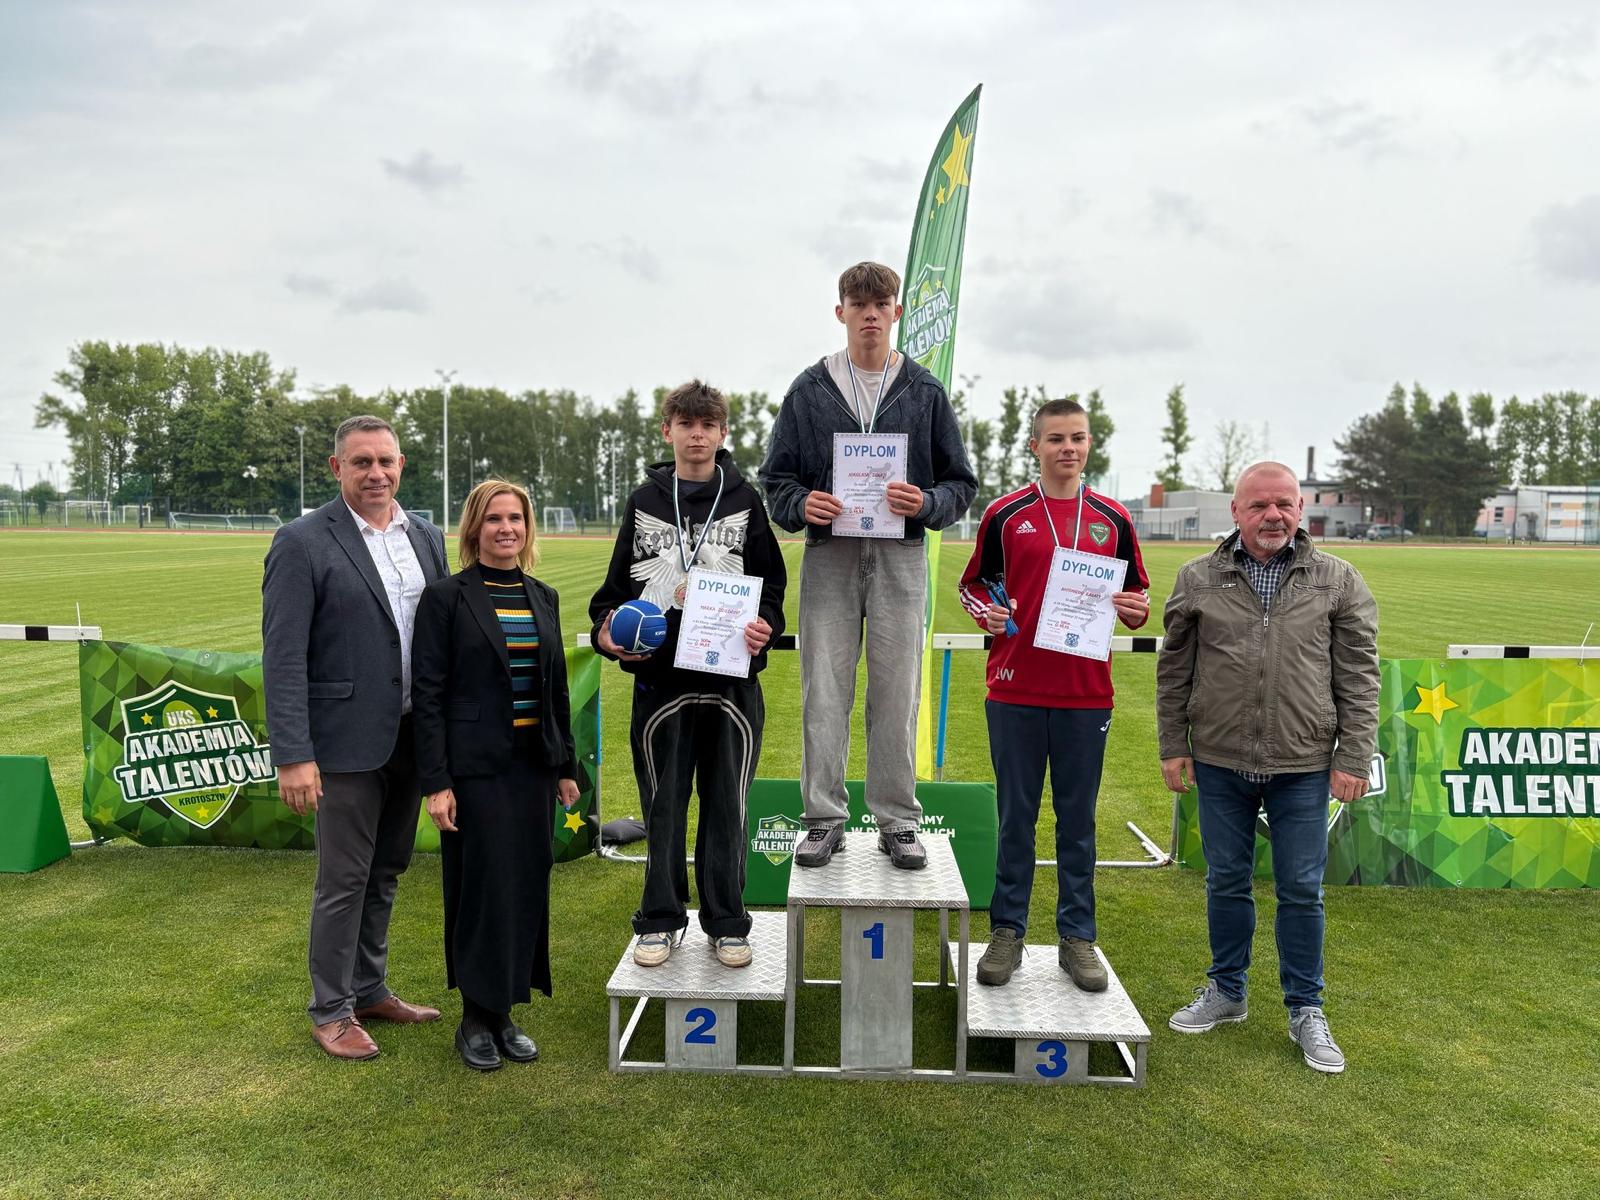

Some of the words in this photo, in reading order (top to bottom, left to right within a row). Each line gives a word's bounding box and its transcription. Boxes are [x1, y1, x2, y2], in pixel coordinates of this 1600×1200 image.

[844, 445, 896, 457] DYPLOM
[1061, 560, 1115, 581] DYPLOM
[698, 579, 751, 597] DYPLOM
[166, 709, 196, 727] UKS
[129, 725, 252, 762] AKADEMIA
[120, 749, 273, 797] TALENTÓW
[178, 792, 227, 807] KROTOSZYN
[758, 831, 797, 840] AKADEMI
[753, 840, 797, 851] TALENTÓ
[862, 922, 884, 960] 1
[684, 1007, 717, 1044] 2
[1035, 1040, 1069, 1078] 3
